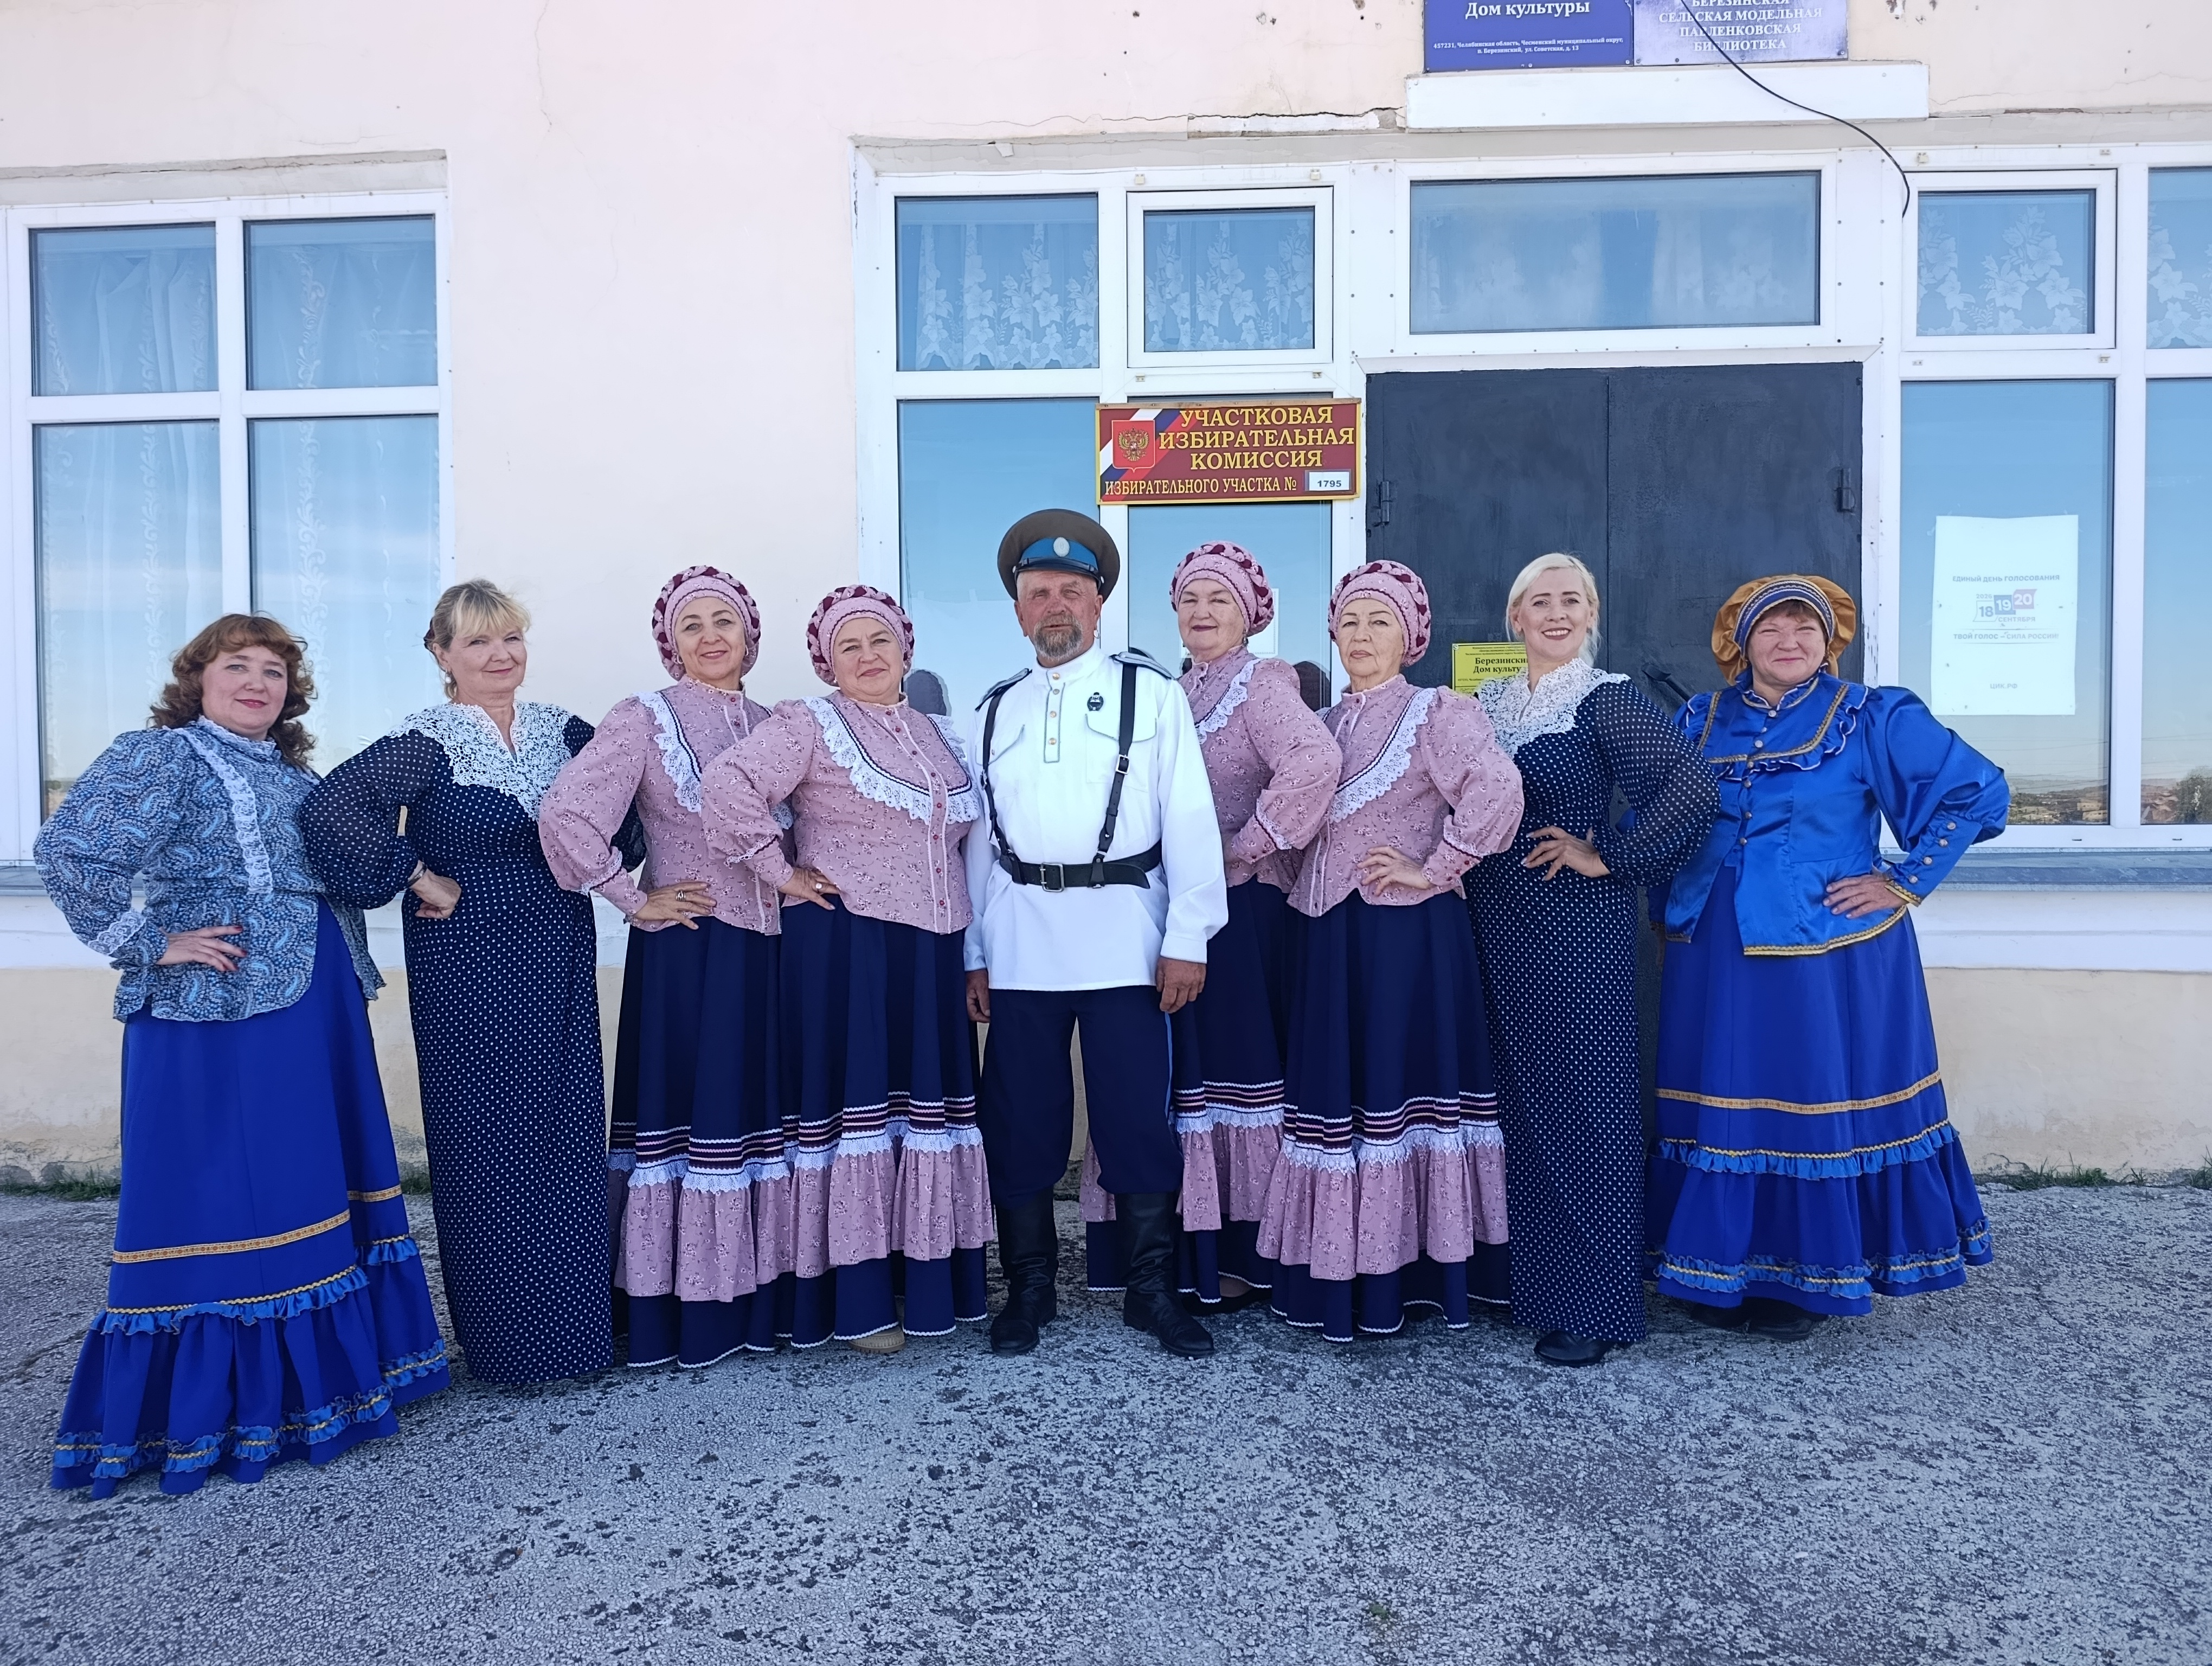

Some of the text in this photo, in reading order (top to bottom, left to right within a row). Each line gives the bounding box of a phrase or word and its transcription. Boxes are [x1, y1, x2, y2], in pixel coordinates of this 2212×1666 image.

[1465, 2, 1590, 19] Дом культуры
[1659, 8, 1822, 23] СЕЛЬСКАЯ МОДЕЛЬНАЯ
[1680, 23, 1801, 37] ПАВЛЕНКОВСКАЯ
[1694, 39, 1786, 52] БИБЛИОТЕКА
[1179, 407, 1333, 427] УЧАСТКОВАЯ
[1159, 427, 1354, 450] ИЗБИРАТЕЛЬНАЯ
[1191, 450, 1323, 470] КОМИССИЯ
[1105, 476, 1342, 496] ИЗБИРАТЕЛЬНОГО УЧАСТКА № 1795
[1979, 593, 2033, 617] 18 19 20
[1475, 657, 1528, 665] Березински
